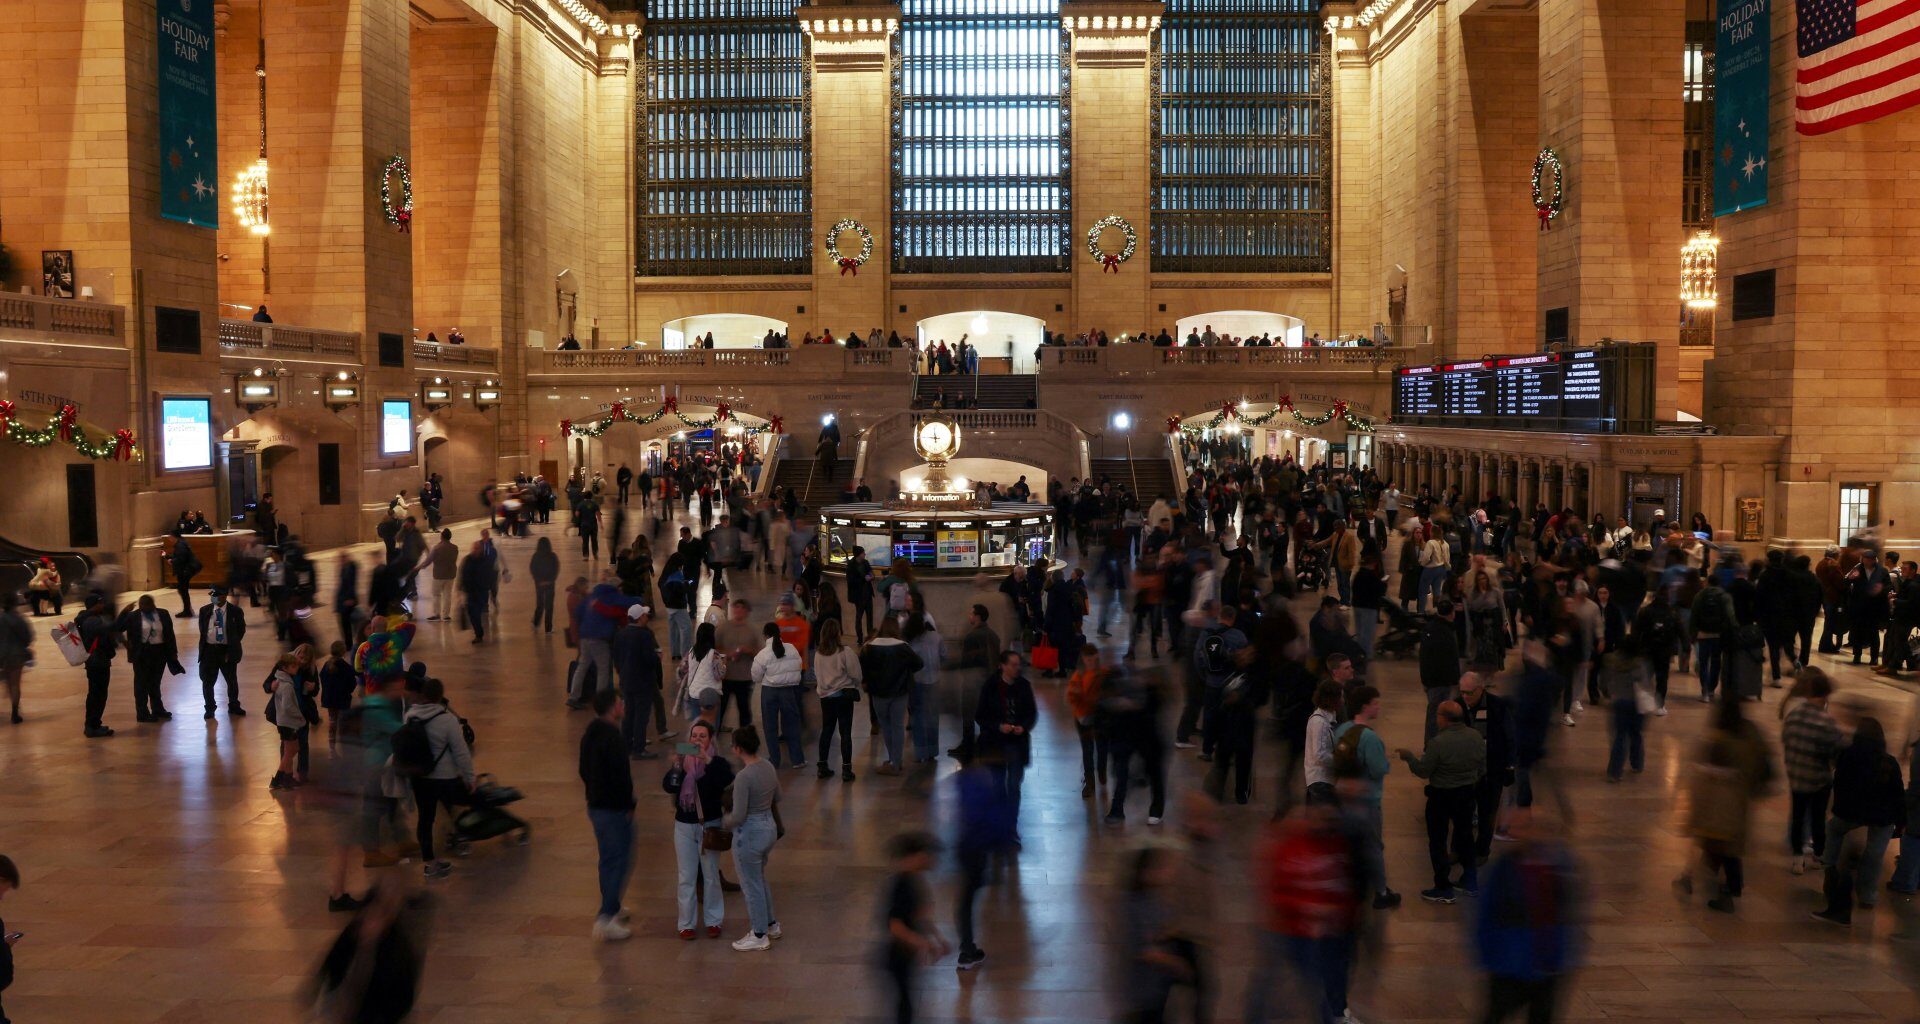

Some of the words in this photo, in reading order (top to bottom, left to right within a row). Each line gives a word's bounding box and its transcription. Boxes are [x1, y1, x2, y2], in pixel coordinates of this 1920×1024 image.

[1720, 0, 1765, 33] HOLIDAY
[161, 16, 210, 51] HOLIDAY
[1731, 21, 1754, 46] FAIR
[175, 40, 199, 63] FAIR
[19, 390, 45, 404] 45TH
[1255, 393, 1271, 401] AVE
[1298, 392, 1328, 403] TICKET
[734, 402, 750, 410] AVE
[922, 493, 960, 502] Information
